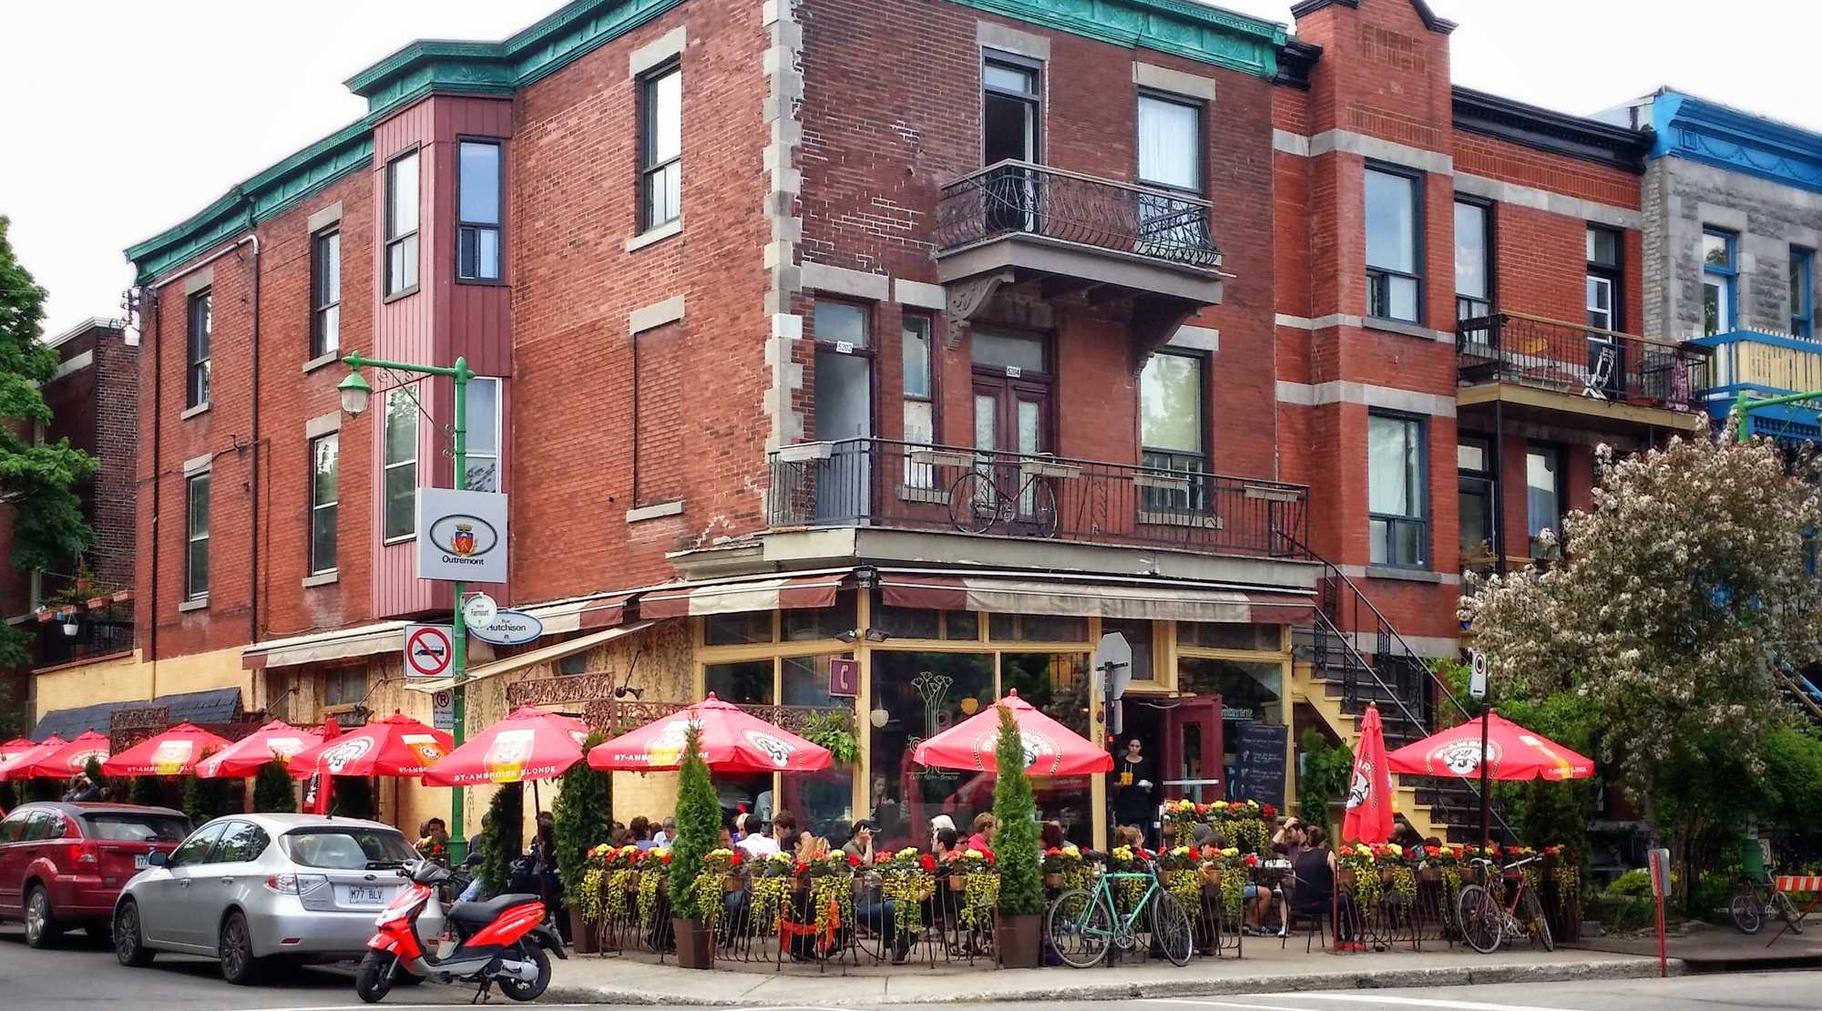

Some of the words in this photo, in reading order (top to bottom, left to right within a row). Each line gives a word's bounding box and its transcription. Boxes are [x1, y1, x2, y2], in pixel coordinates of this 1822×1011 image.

[442, 555, 484, 565] Outremont
[486, 623, 526, 632] Hutchison
[454, 769, 516, 782] ST-AMBROISE
[521, 765, 556, 776] BLONDE
